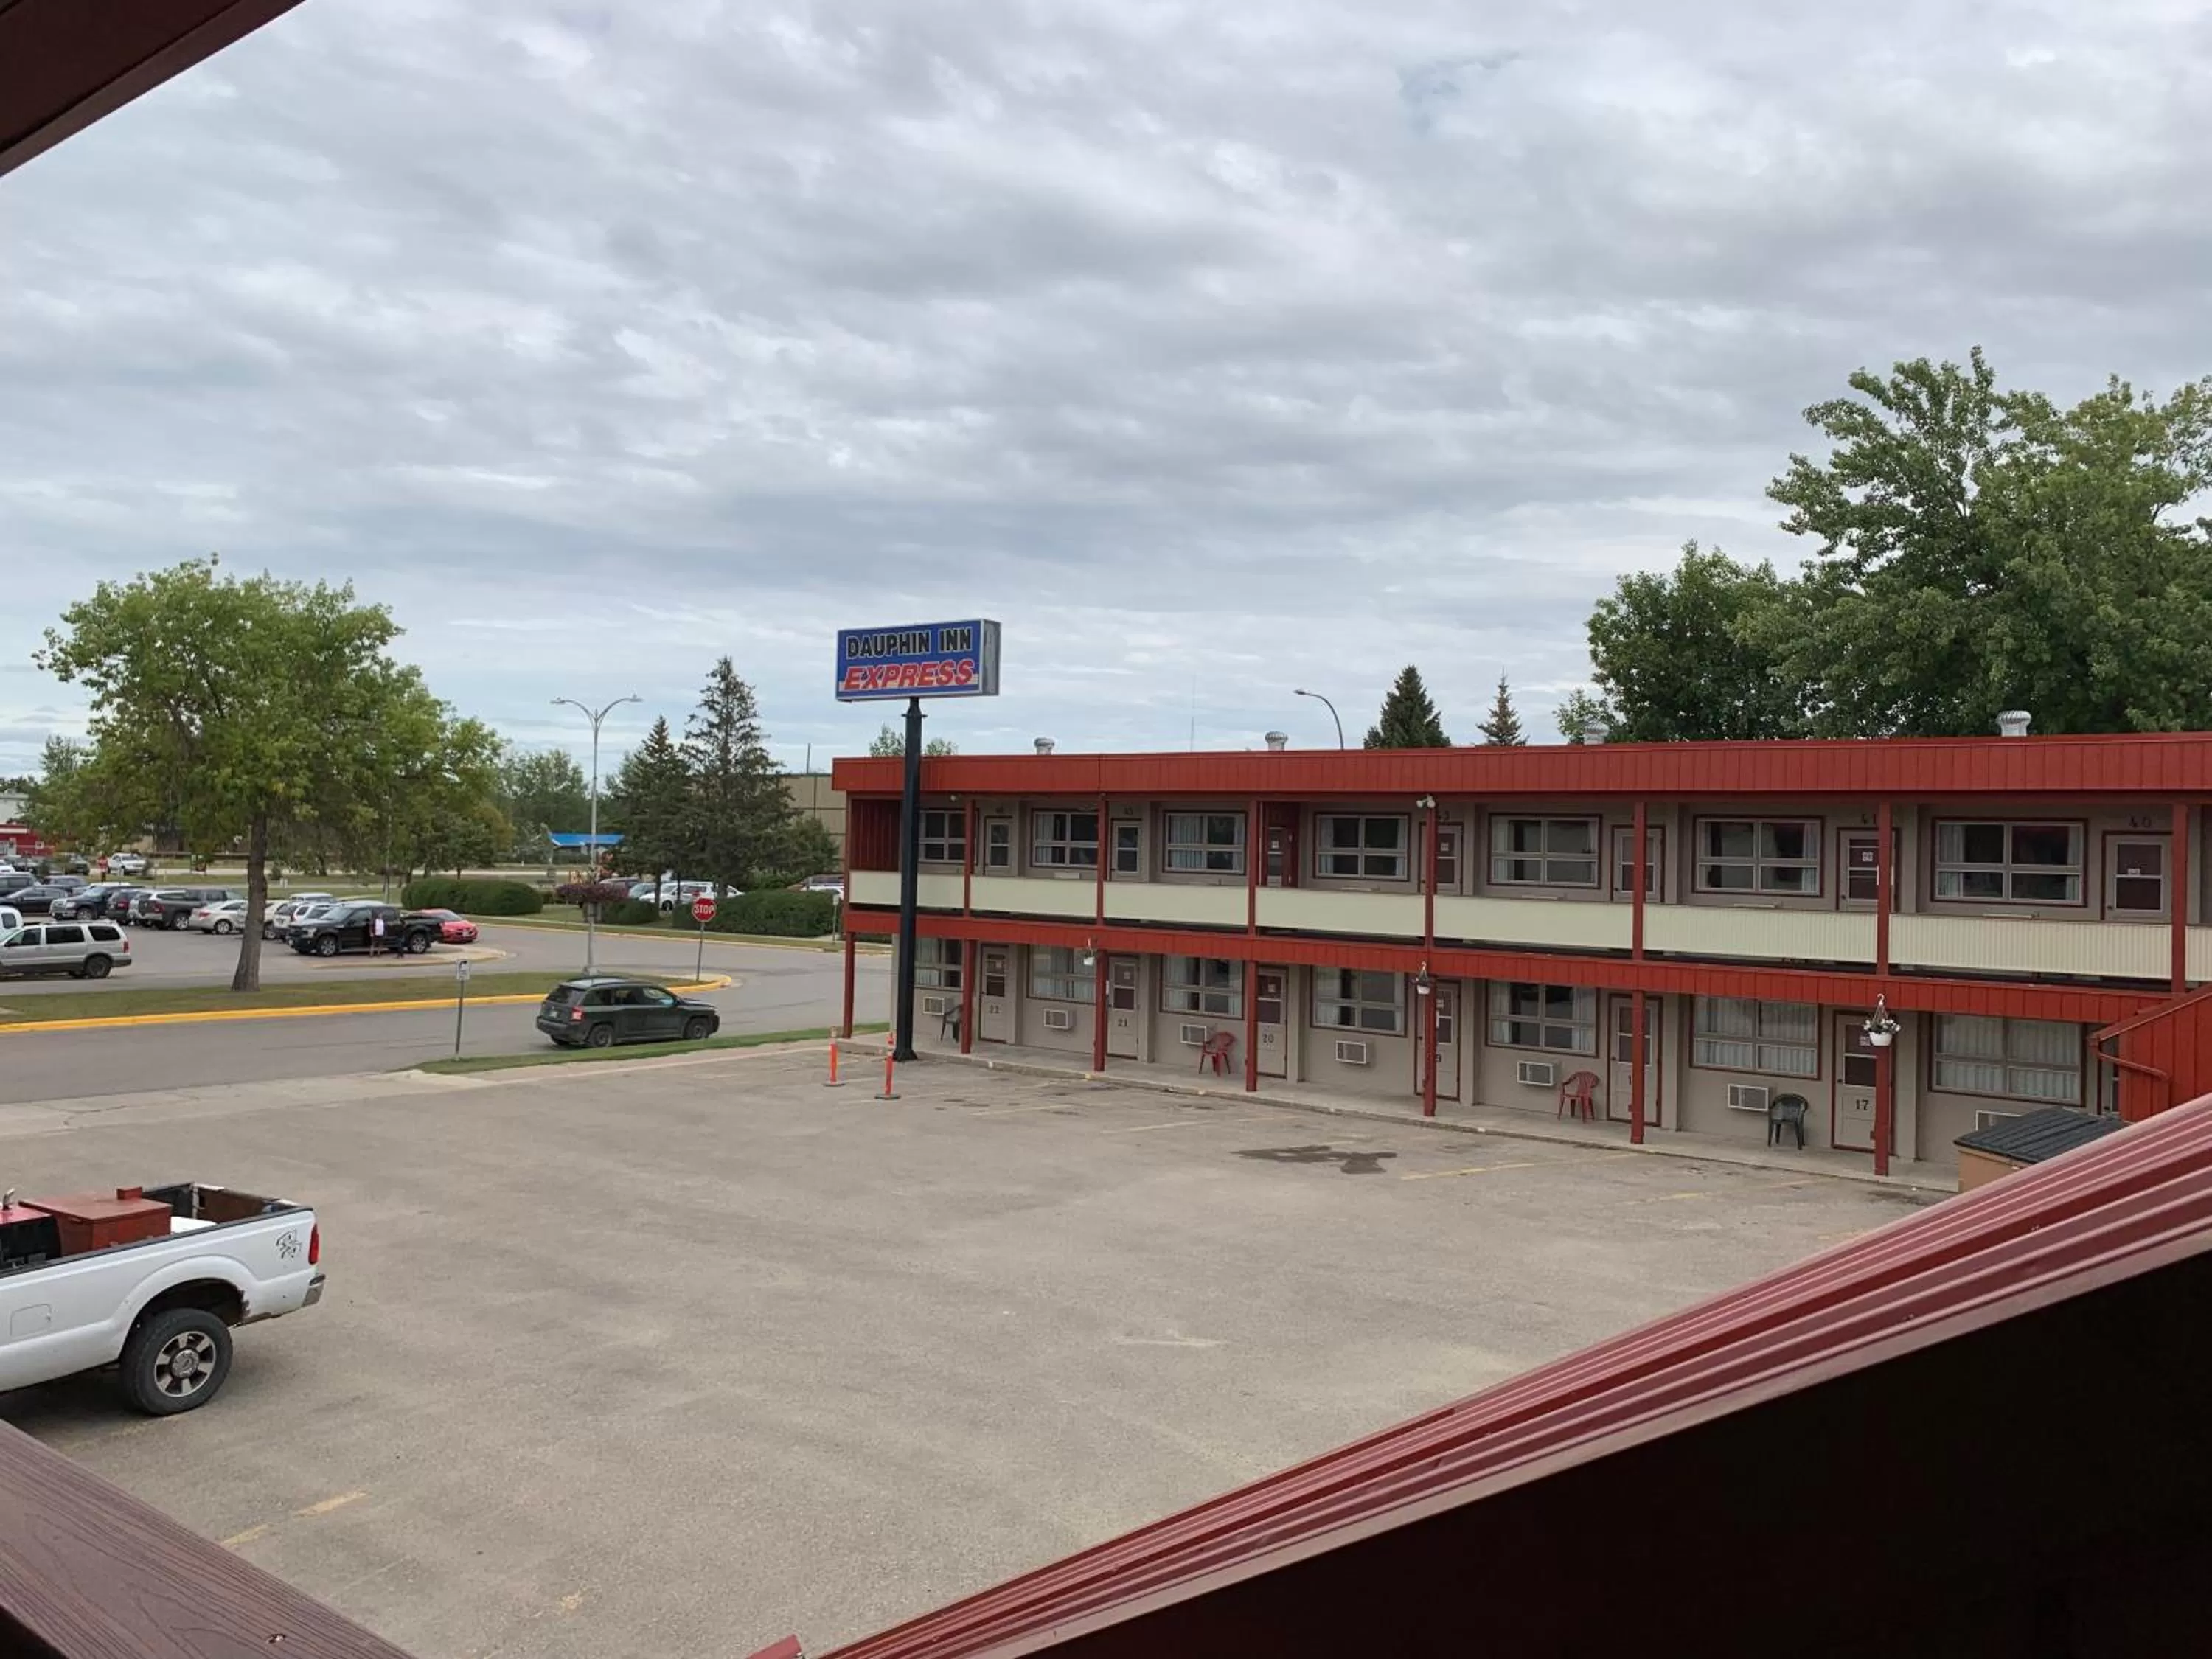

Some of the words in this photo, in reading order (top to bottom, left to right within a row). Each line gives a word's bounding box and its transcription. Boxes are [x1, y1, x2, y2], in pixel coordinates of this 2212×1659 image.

[846, 630, 931, 659] DAUPHIN
[939, 627, 973, 653] INN
[844, 658, 974, 690] EXPRESS
[693, 904, 715, 915] STOP
[1856, 1099, 1870, 1111] 17
